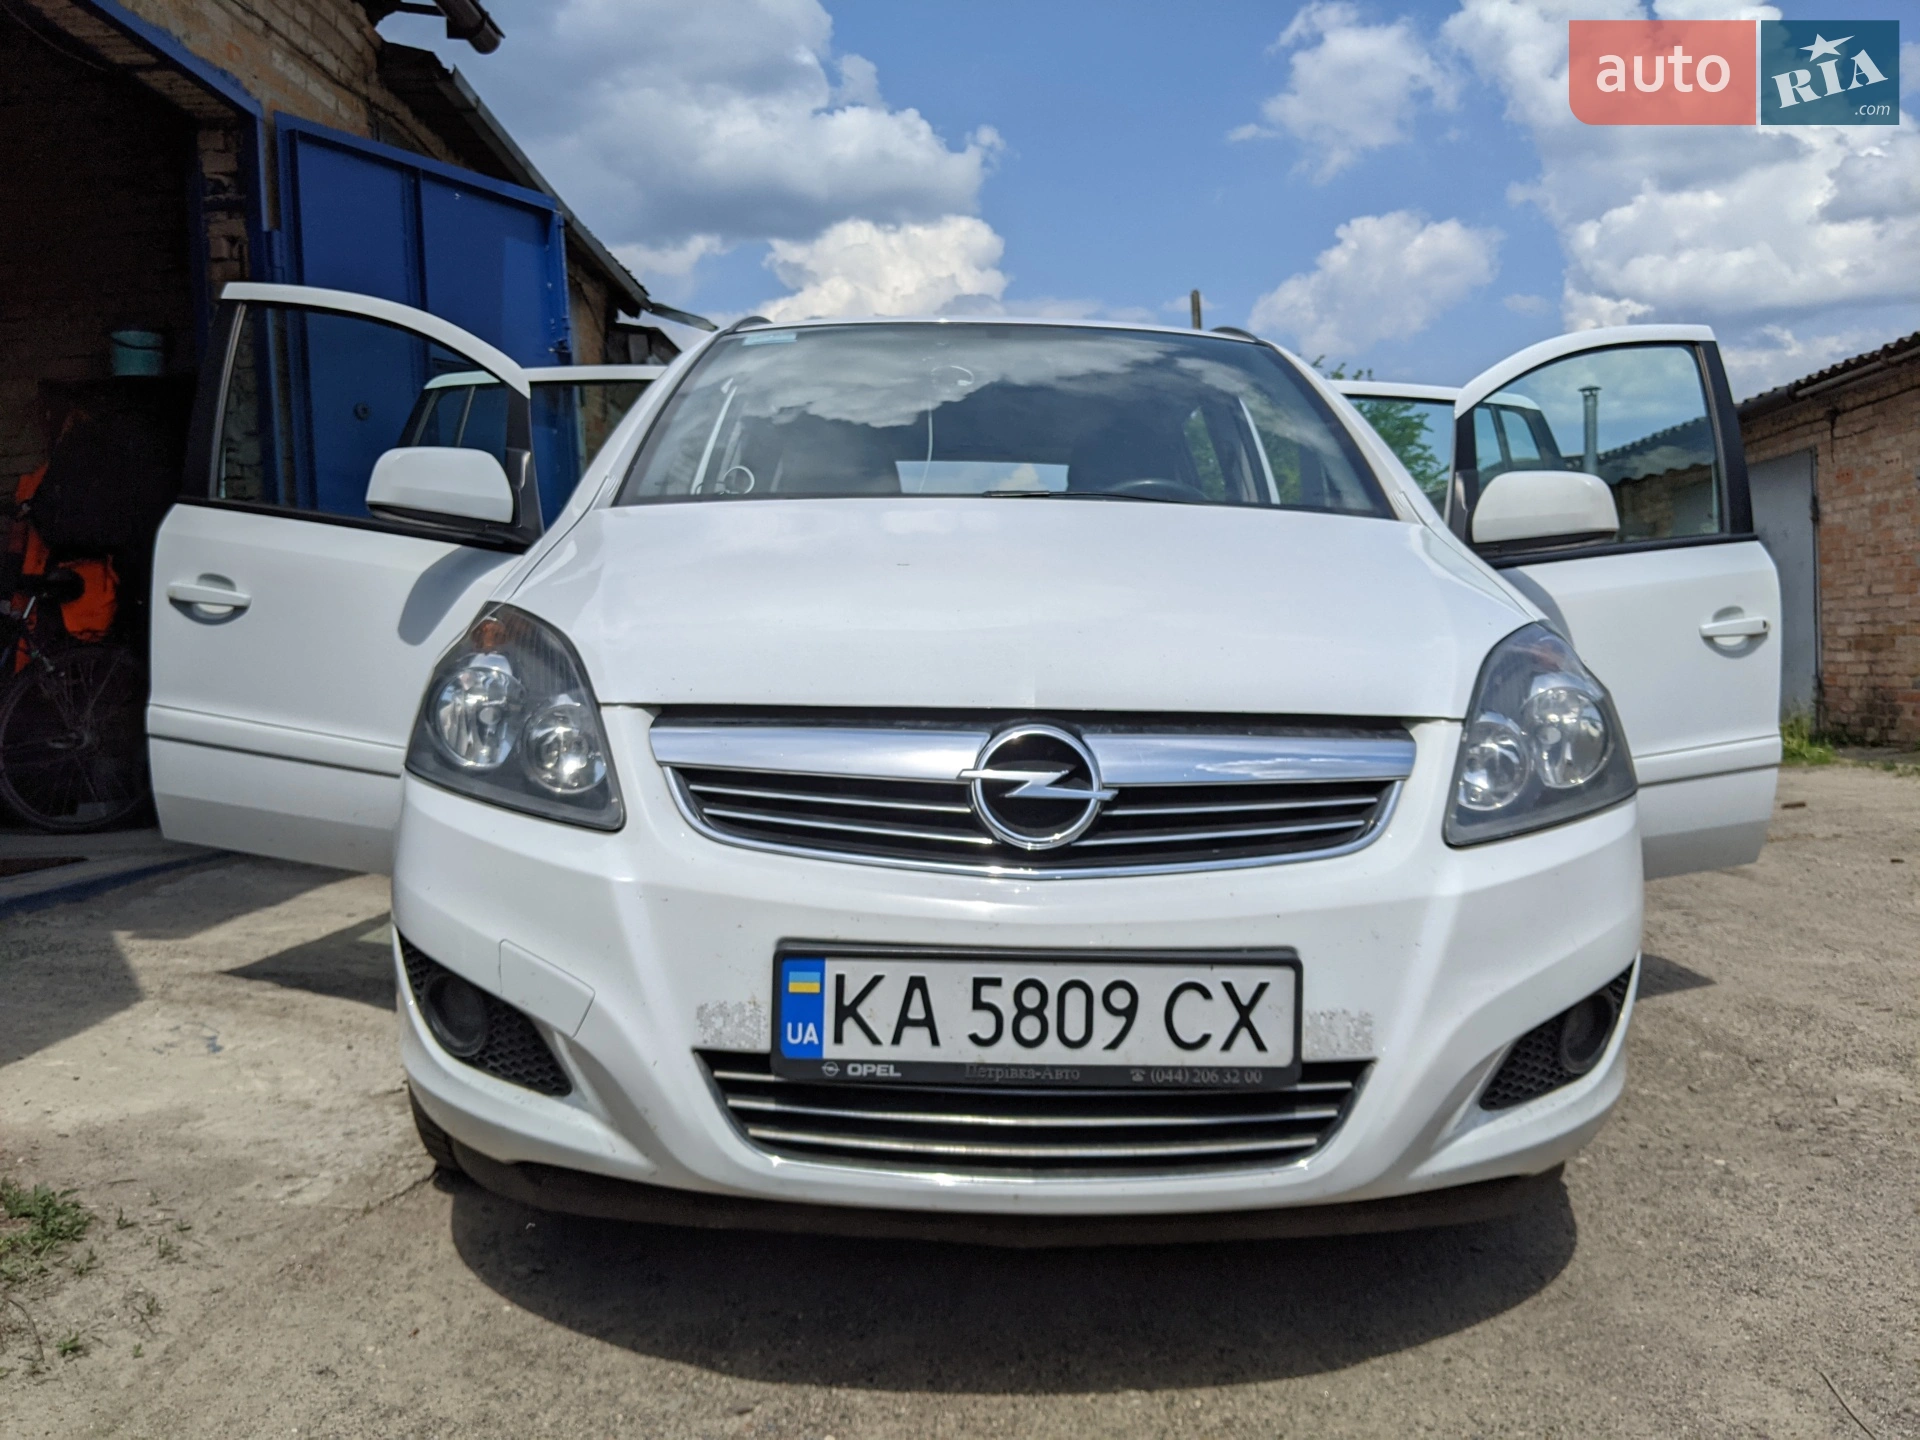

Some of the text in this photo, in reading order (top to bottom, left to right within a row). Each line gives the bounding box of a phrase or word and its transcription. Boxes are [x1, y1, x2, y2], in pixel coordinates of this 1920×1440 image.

[833, 973, 1271, 1053] KA 5809 CX
[786, 1022, 819, 1045] UA
[846, 1063, 902, 1077] OPEL
[1150, 1068, 1263, 1084] (044) 206 32 00
